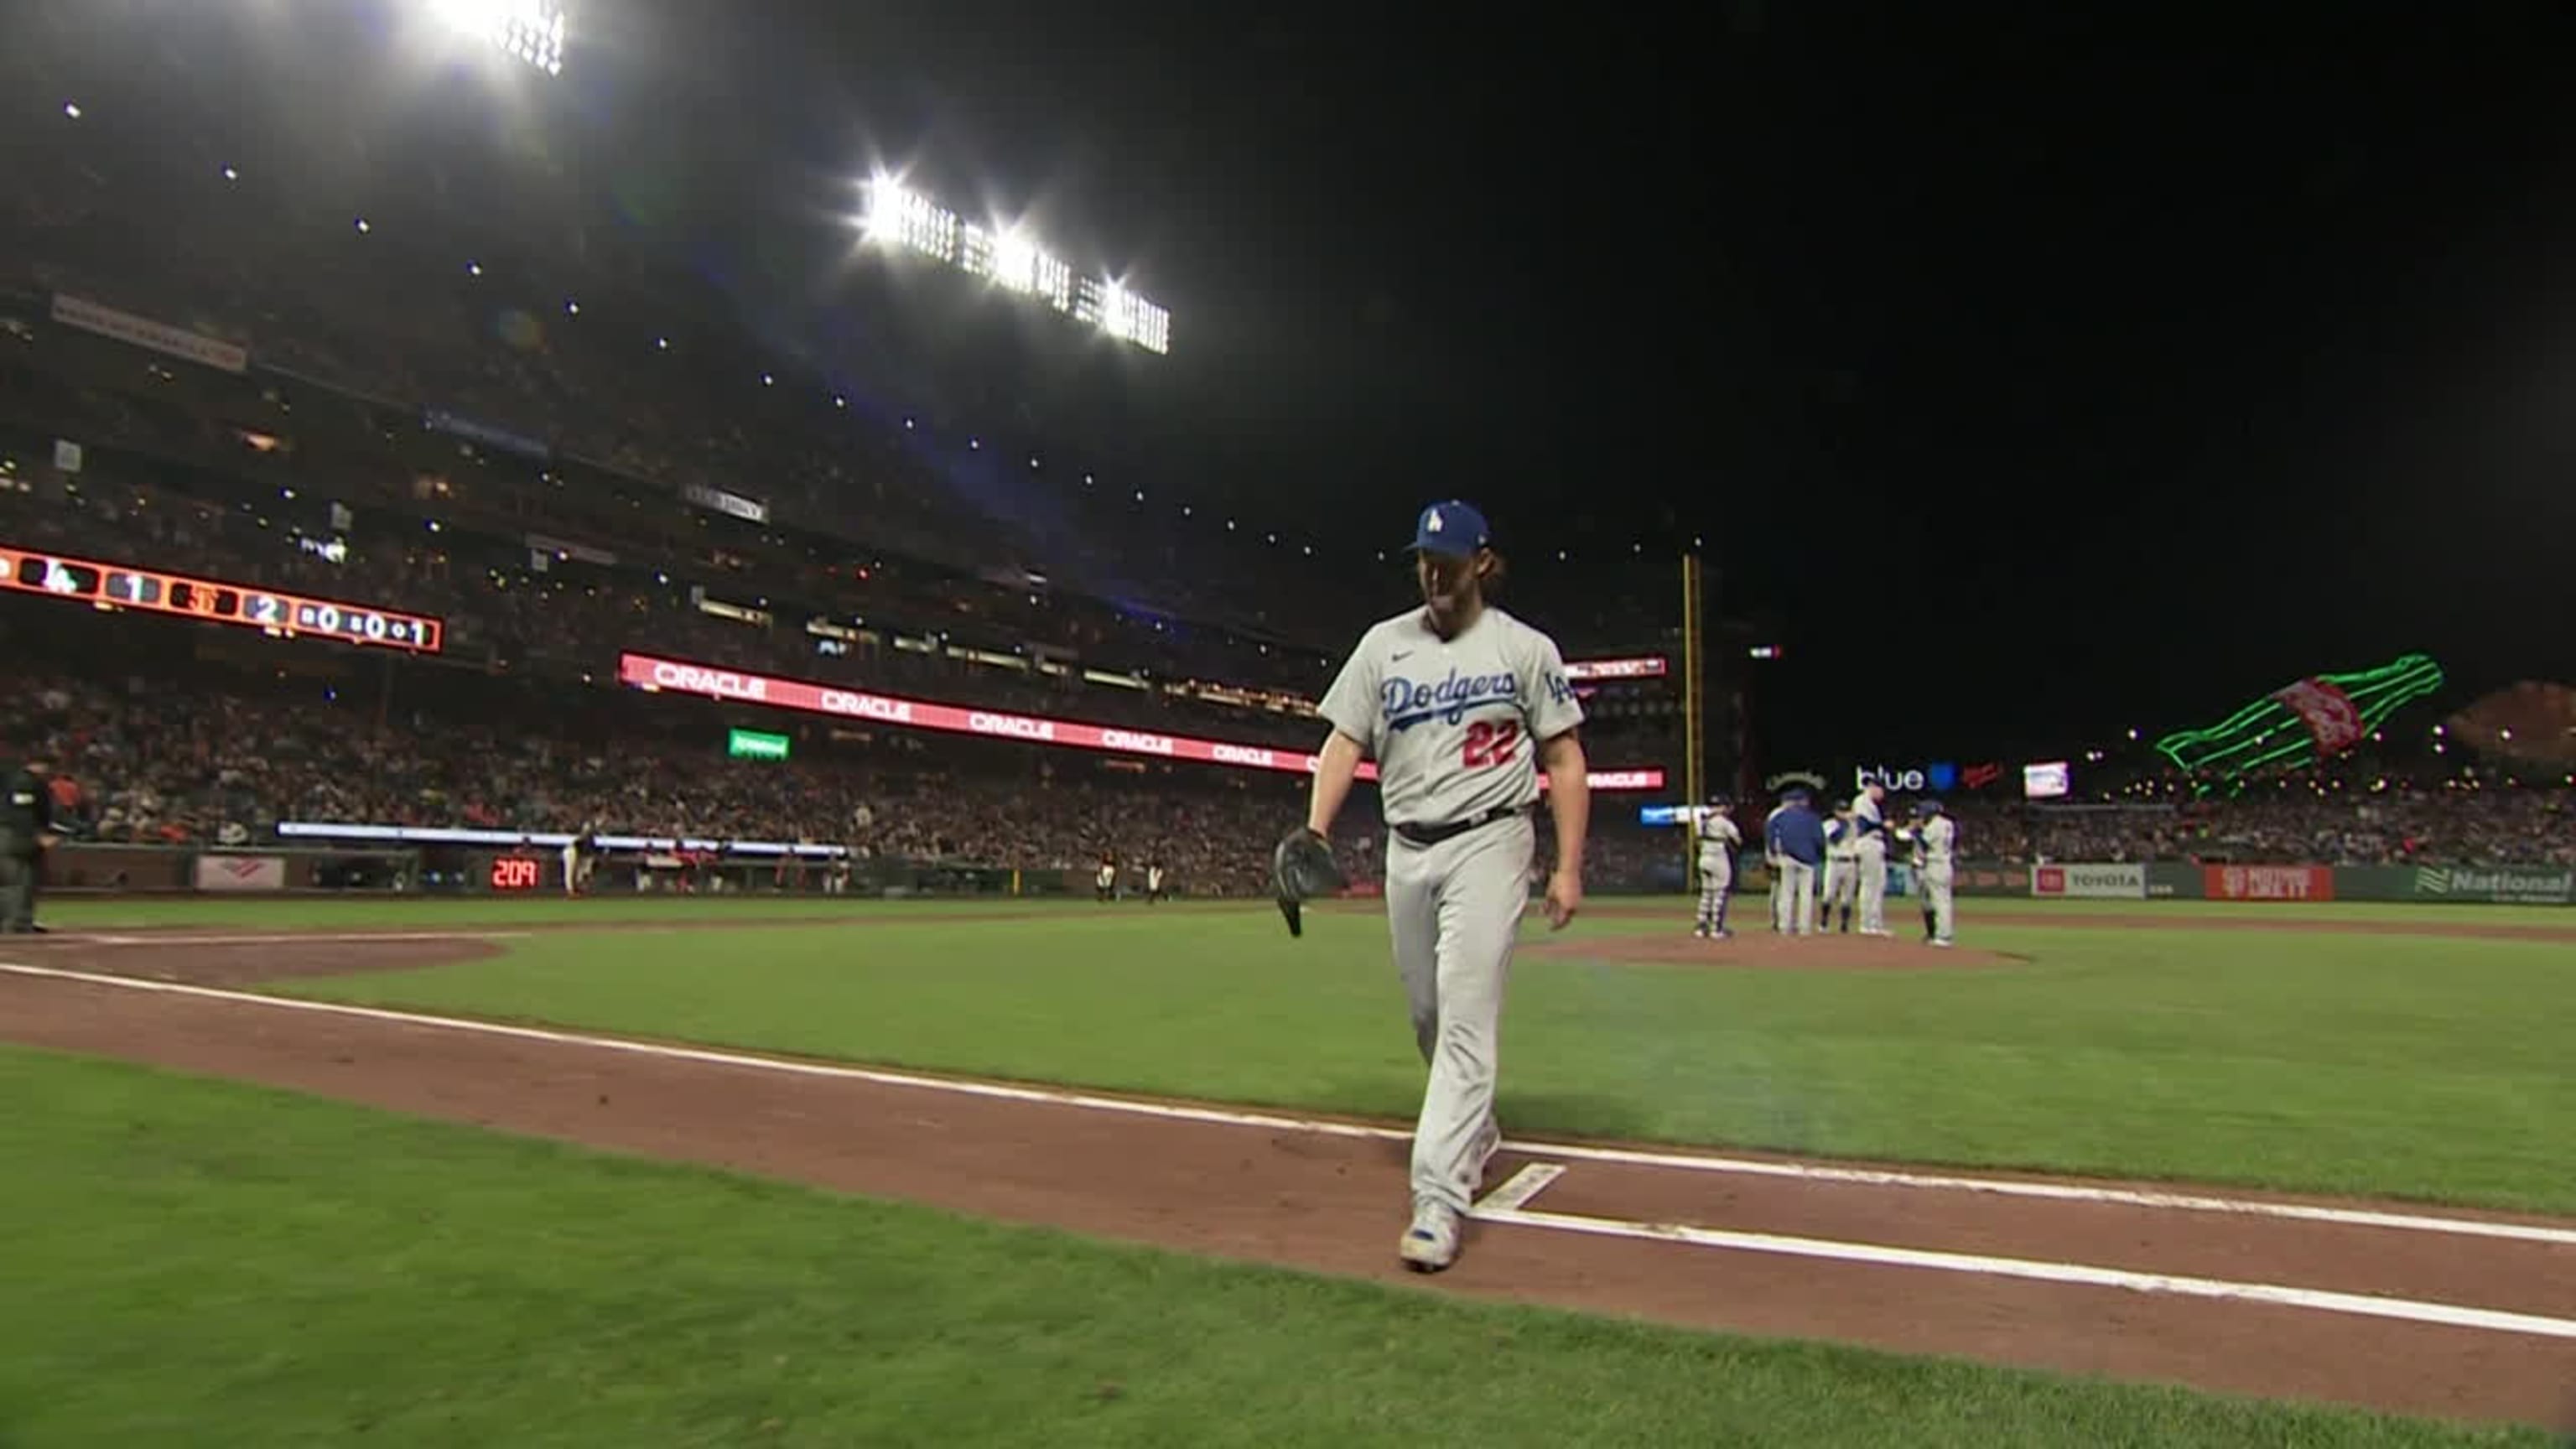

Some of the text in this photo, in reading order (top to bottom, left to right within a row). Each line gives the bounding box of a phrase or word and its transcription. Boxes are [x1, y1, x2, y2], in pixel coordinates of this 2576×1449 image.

[256, 596, 278, 623] 2
[1380, 668, 1515, 726] Dodgers
[1545, 672, 1577, 707] LA
[654, 662, 767, 700] ORACLE
[821, 691, 911, 722] ORACLE
[969, 713, 1054, 741] ORACLE
[1102, 730, 1173, 755] ORACLE
[1213, 743, 1273, 766] ORACLE
[1463, 719, 1518, 768] 22
[1857, 764, 1924, 791] blue
[492, 860, 536, 886] 209
[2073, 874, 2141, 887] TOYOTA
[2452, 870, 2573, 892] National
